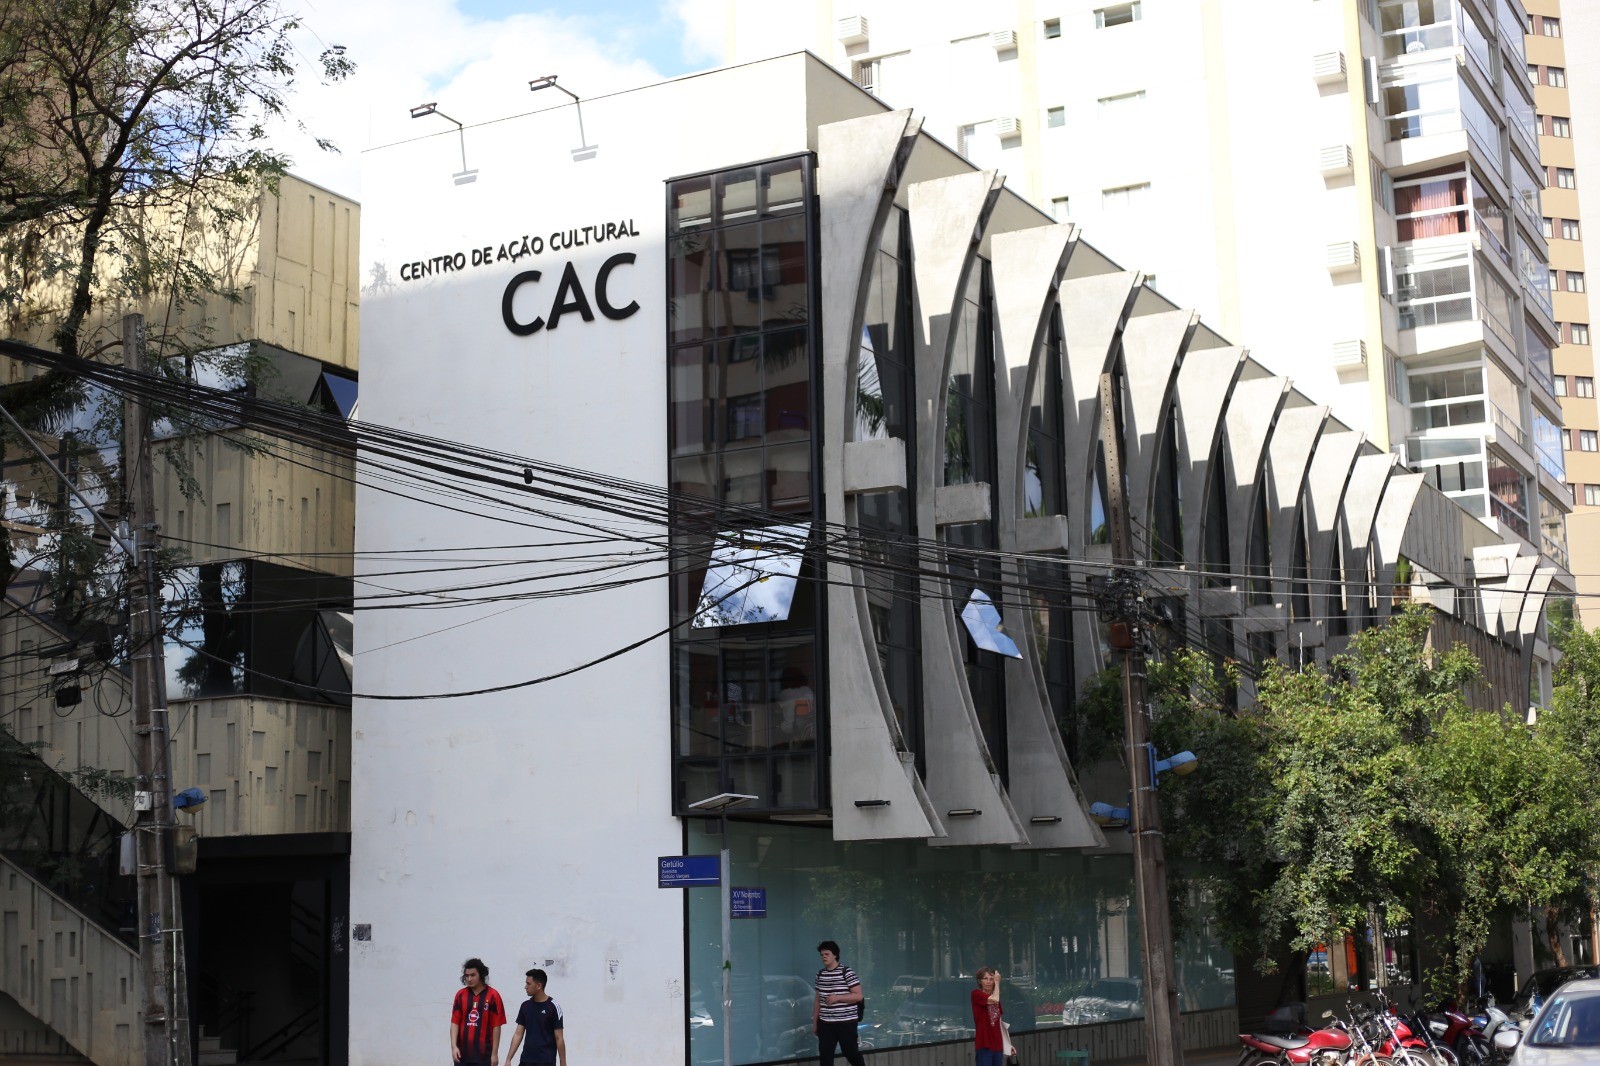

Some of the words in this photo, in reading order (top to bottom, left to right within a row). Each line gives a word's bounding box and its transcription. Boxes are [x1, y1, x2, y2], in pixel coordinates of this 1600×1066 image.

[400, 252, 466, 281] CENTRO
[472, 246, 493, 267] DE
[497, 235, 544, 263] AÇÃO
[550, 219, 640, 251] CULTURAL
[501, 252, 641, 336] CAC
[661, 860, 684, 868] Getúlio
[732, 890, 741, 898] XV
